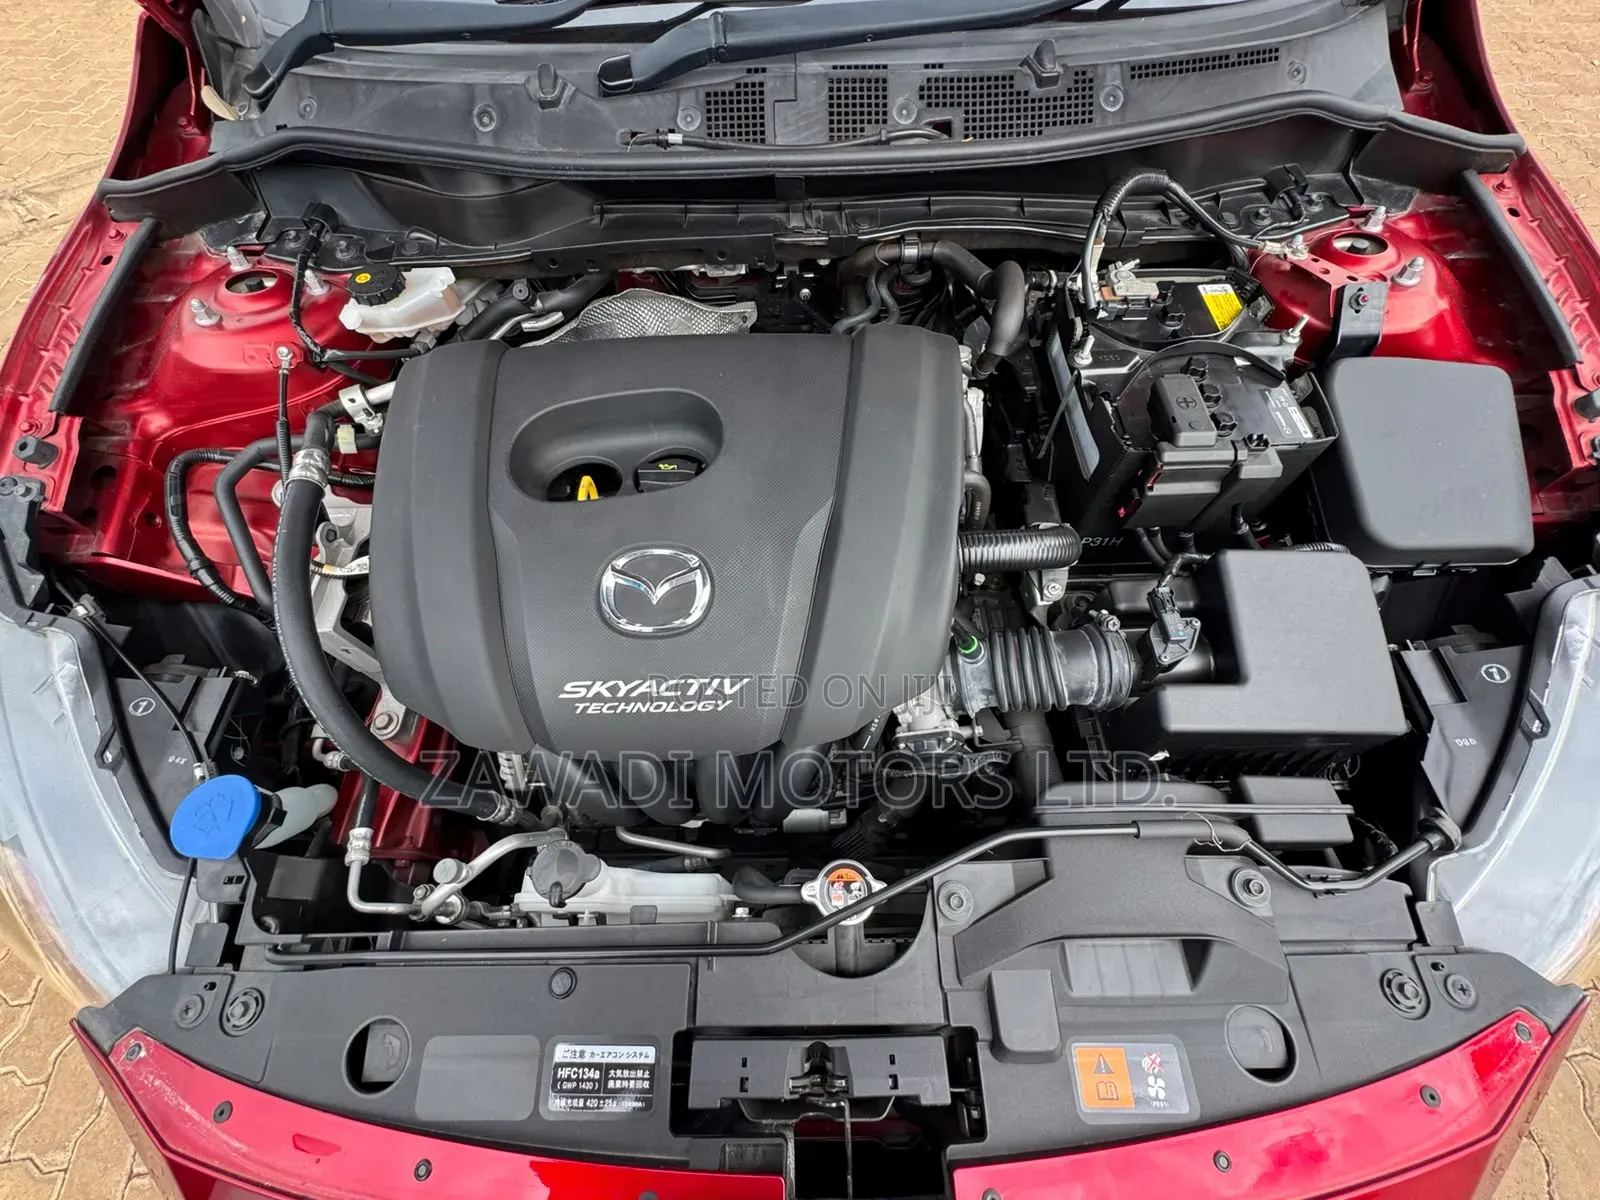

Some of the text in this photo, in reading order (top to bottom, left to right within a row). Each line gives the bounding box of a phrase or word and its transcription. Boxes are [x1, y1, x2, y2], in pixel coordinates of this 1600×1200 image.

[558, 678, 752, 699] SKYACTIV
[574, 699, 734, 715] TECHNOLOGY
[562, 1048, 586, 1059] ご注意
[557, 1067, 600, 1080] HFC134a
